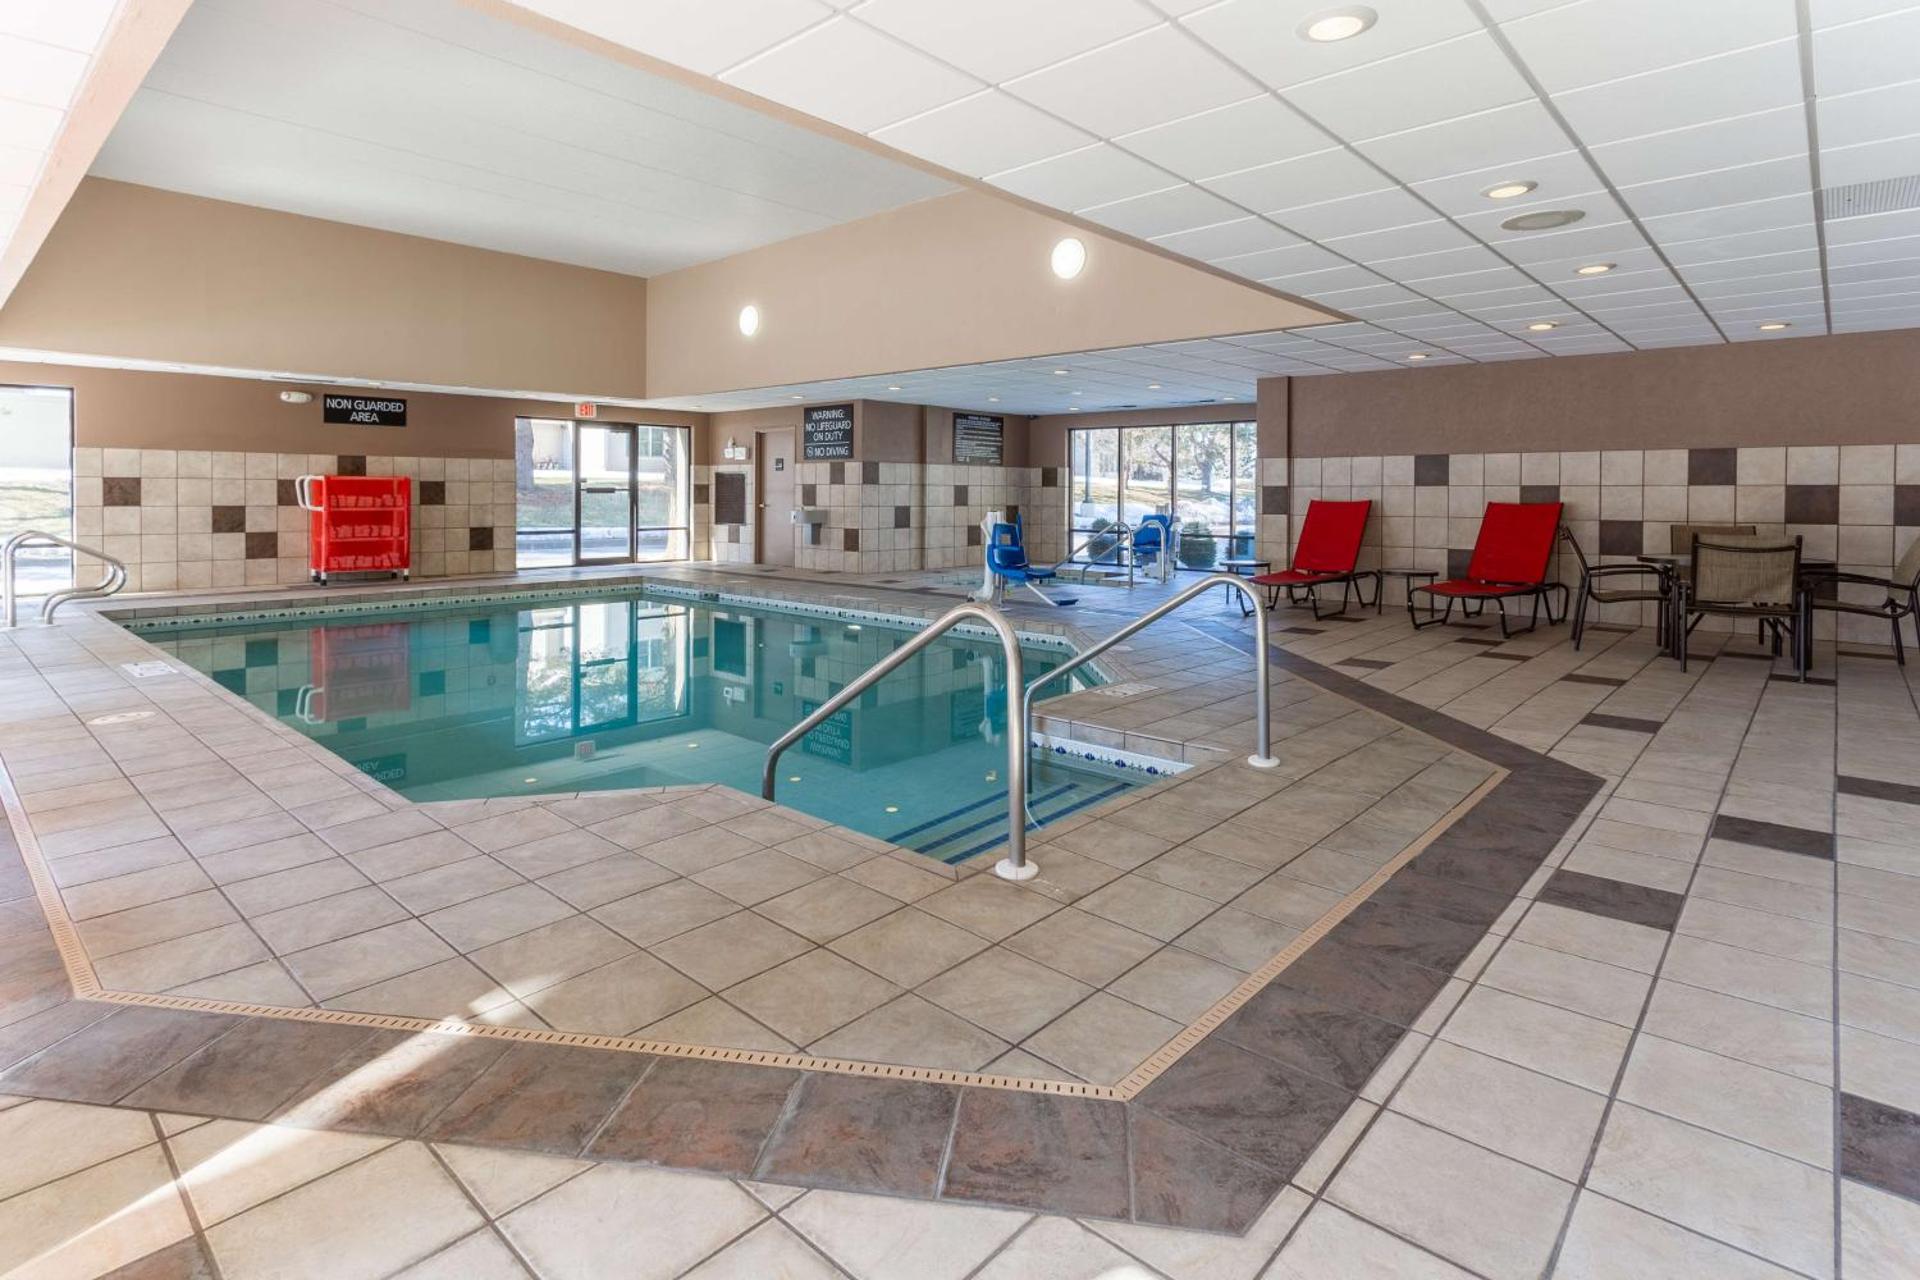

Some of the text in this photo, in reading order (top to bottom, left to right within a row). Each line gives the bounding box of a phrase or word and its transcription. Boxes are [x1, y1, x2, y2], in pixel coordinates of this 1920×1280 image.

[326, 398, 404, 412] NON GUARDED
[579, 402, 595, 416] EXIT
[350, 412, 379, 423] AREA
[806, 420, 851, 431] NO LIFEGUARD
[813, 431, 843, 441] ON DUTY
[815, 446, 849, 457] NO DIVING
